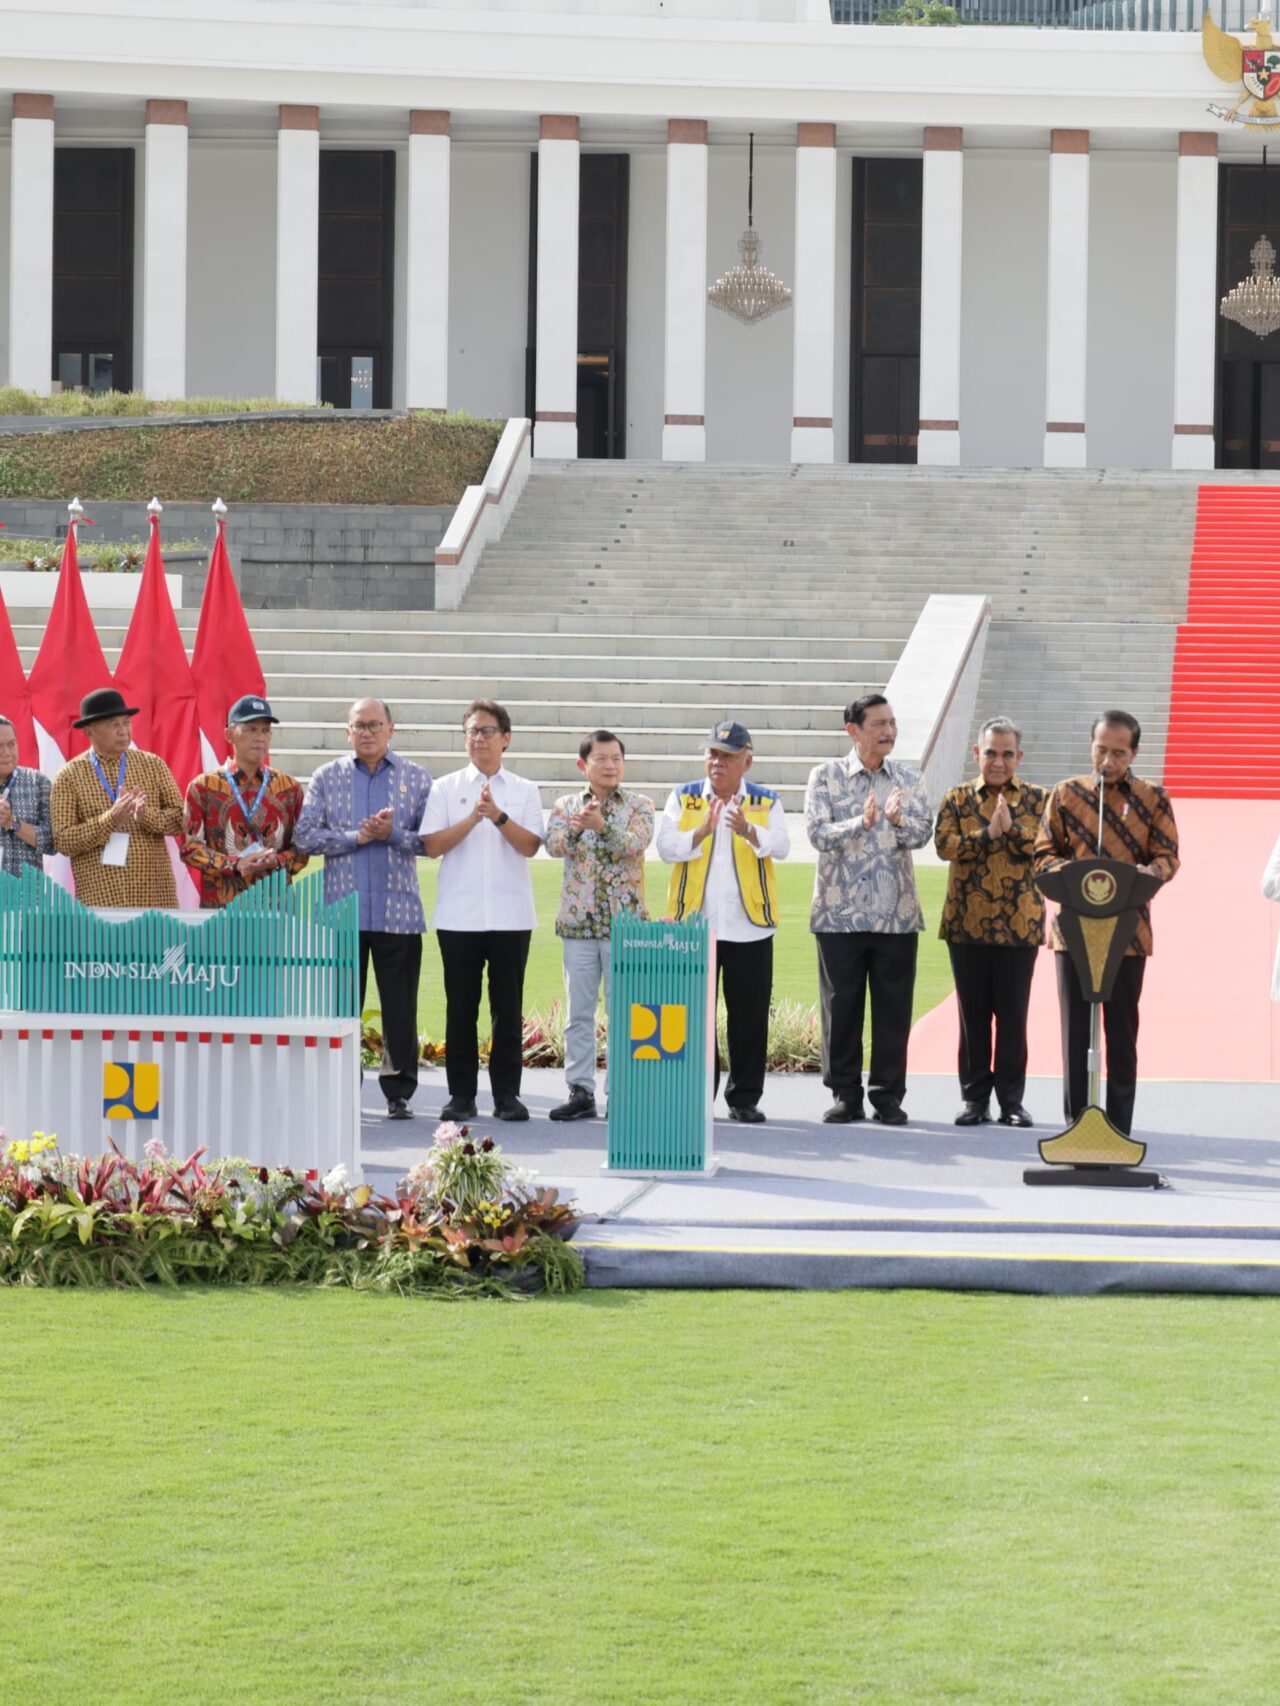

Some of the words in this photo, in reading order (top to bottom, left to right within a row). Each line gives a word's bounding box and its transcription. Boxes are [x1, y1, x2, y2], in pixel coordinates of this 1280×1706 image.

[668, 940, 699, 954] MAJU
[64, 961, 162, 980] INDONESIA
[170, 962, 241, 992] MAJU
